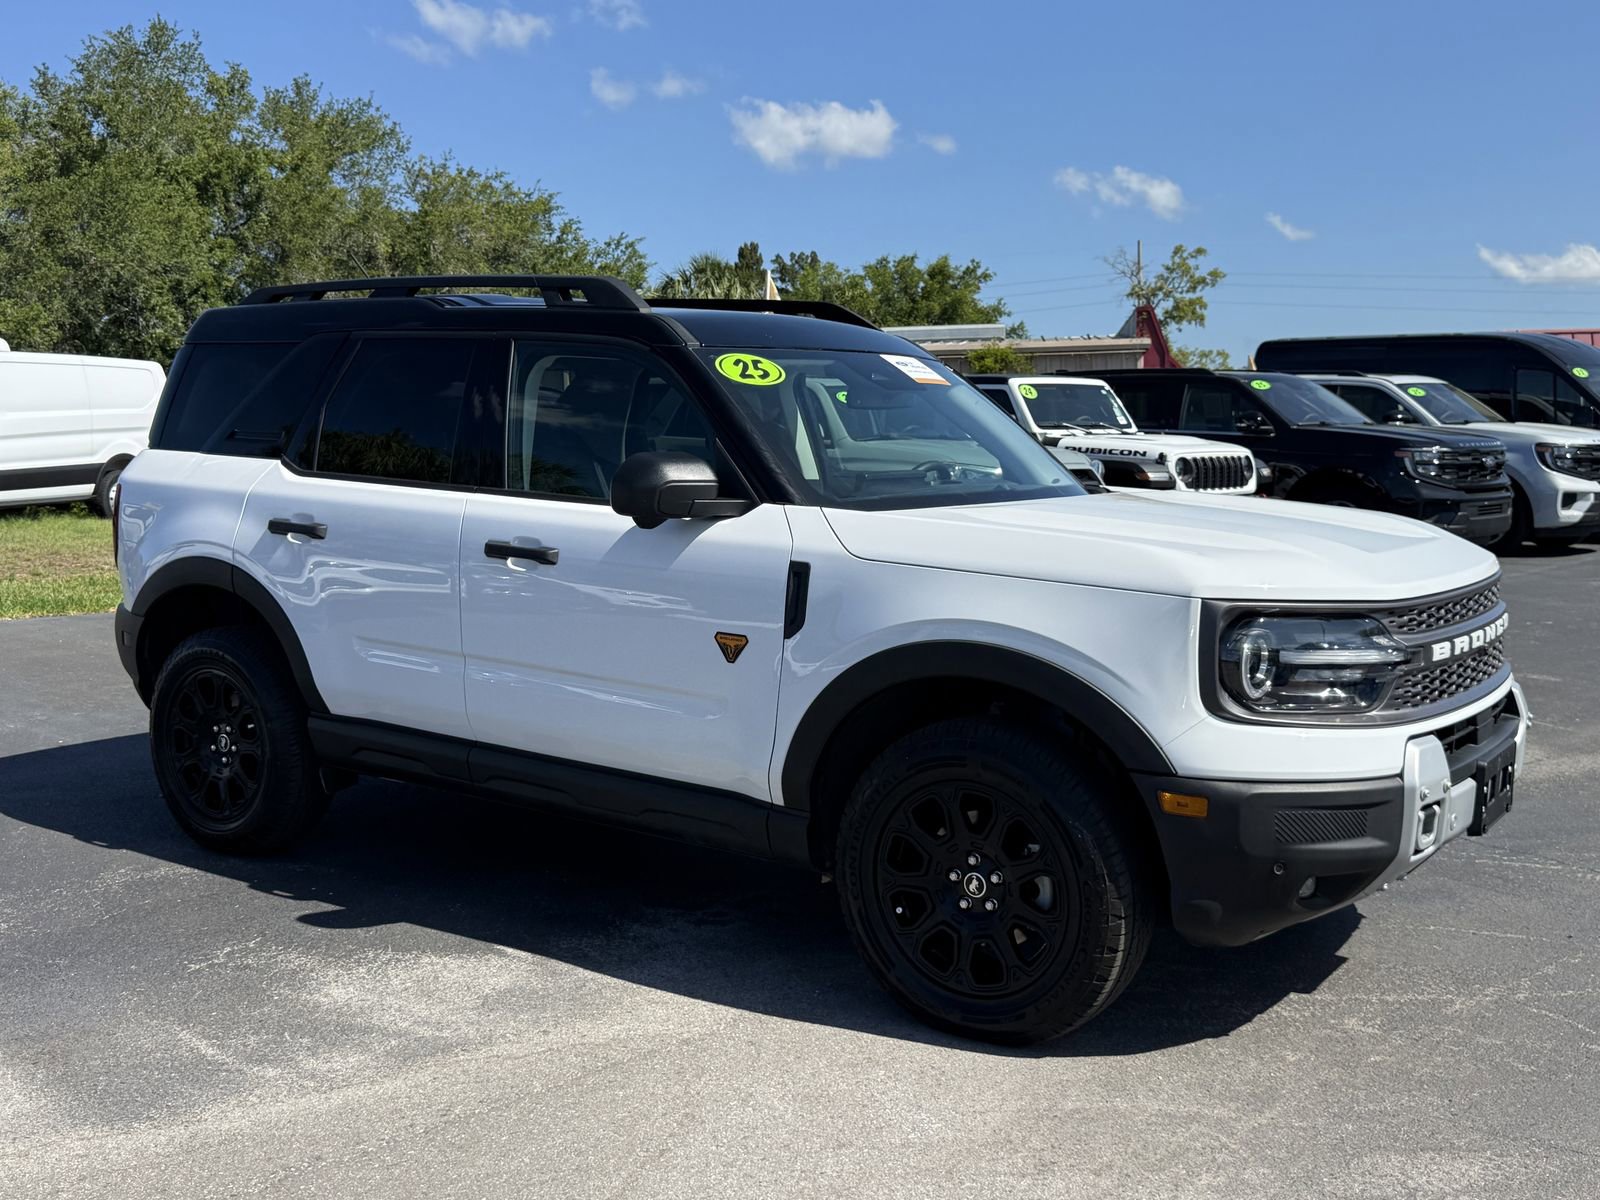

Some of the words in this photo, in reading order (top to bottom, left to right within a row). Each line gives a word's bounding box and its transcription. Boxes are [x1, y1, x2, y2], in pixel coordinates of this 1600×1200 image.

[733, 359, 771, 380] 25
[1064, 446, 1148, 457] RUBICON
[1431, 612, 1509, 662] BRONCO
